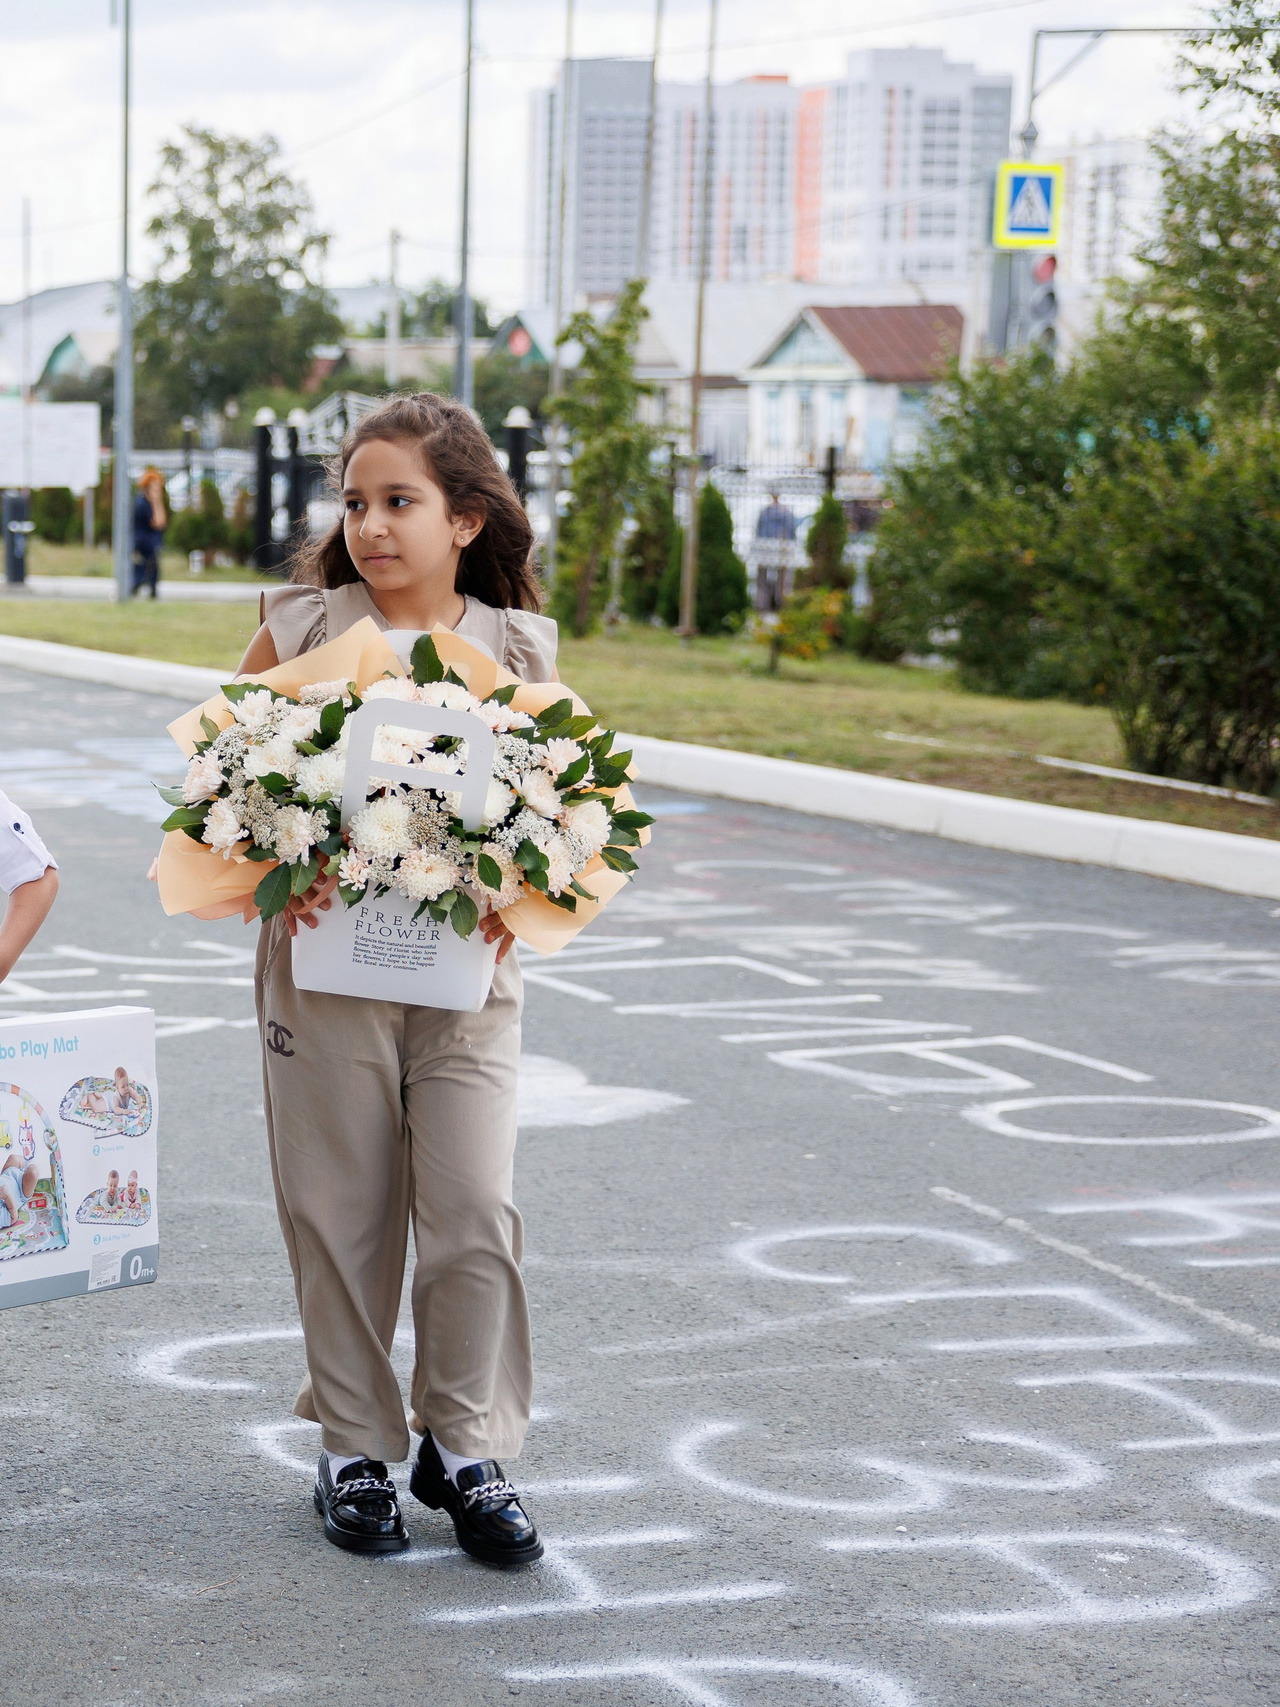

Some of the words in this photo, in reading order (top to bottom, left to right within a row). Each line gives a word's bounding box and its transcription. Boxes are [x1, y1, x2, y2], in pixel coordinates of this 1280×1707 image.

[360, 906, 438, 928] FRESH
[354, 919, 440, 941] FLOWER
[20, 1040, 49, 1059] Play
[54, 1036, 79, 1054] Mat
[130, 1255, 154, 1280] 0m+
